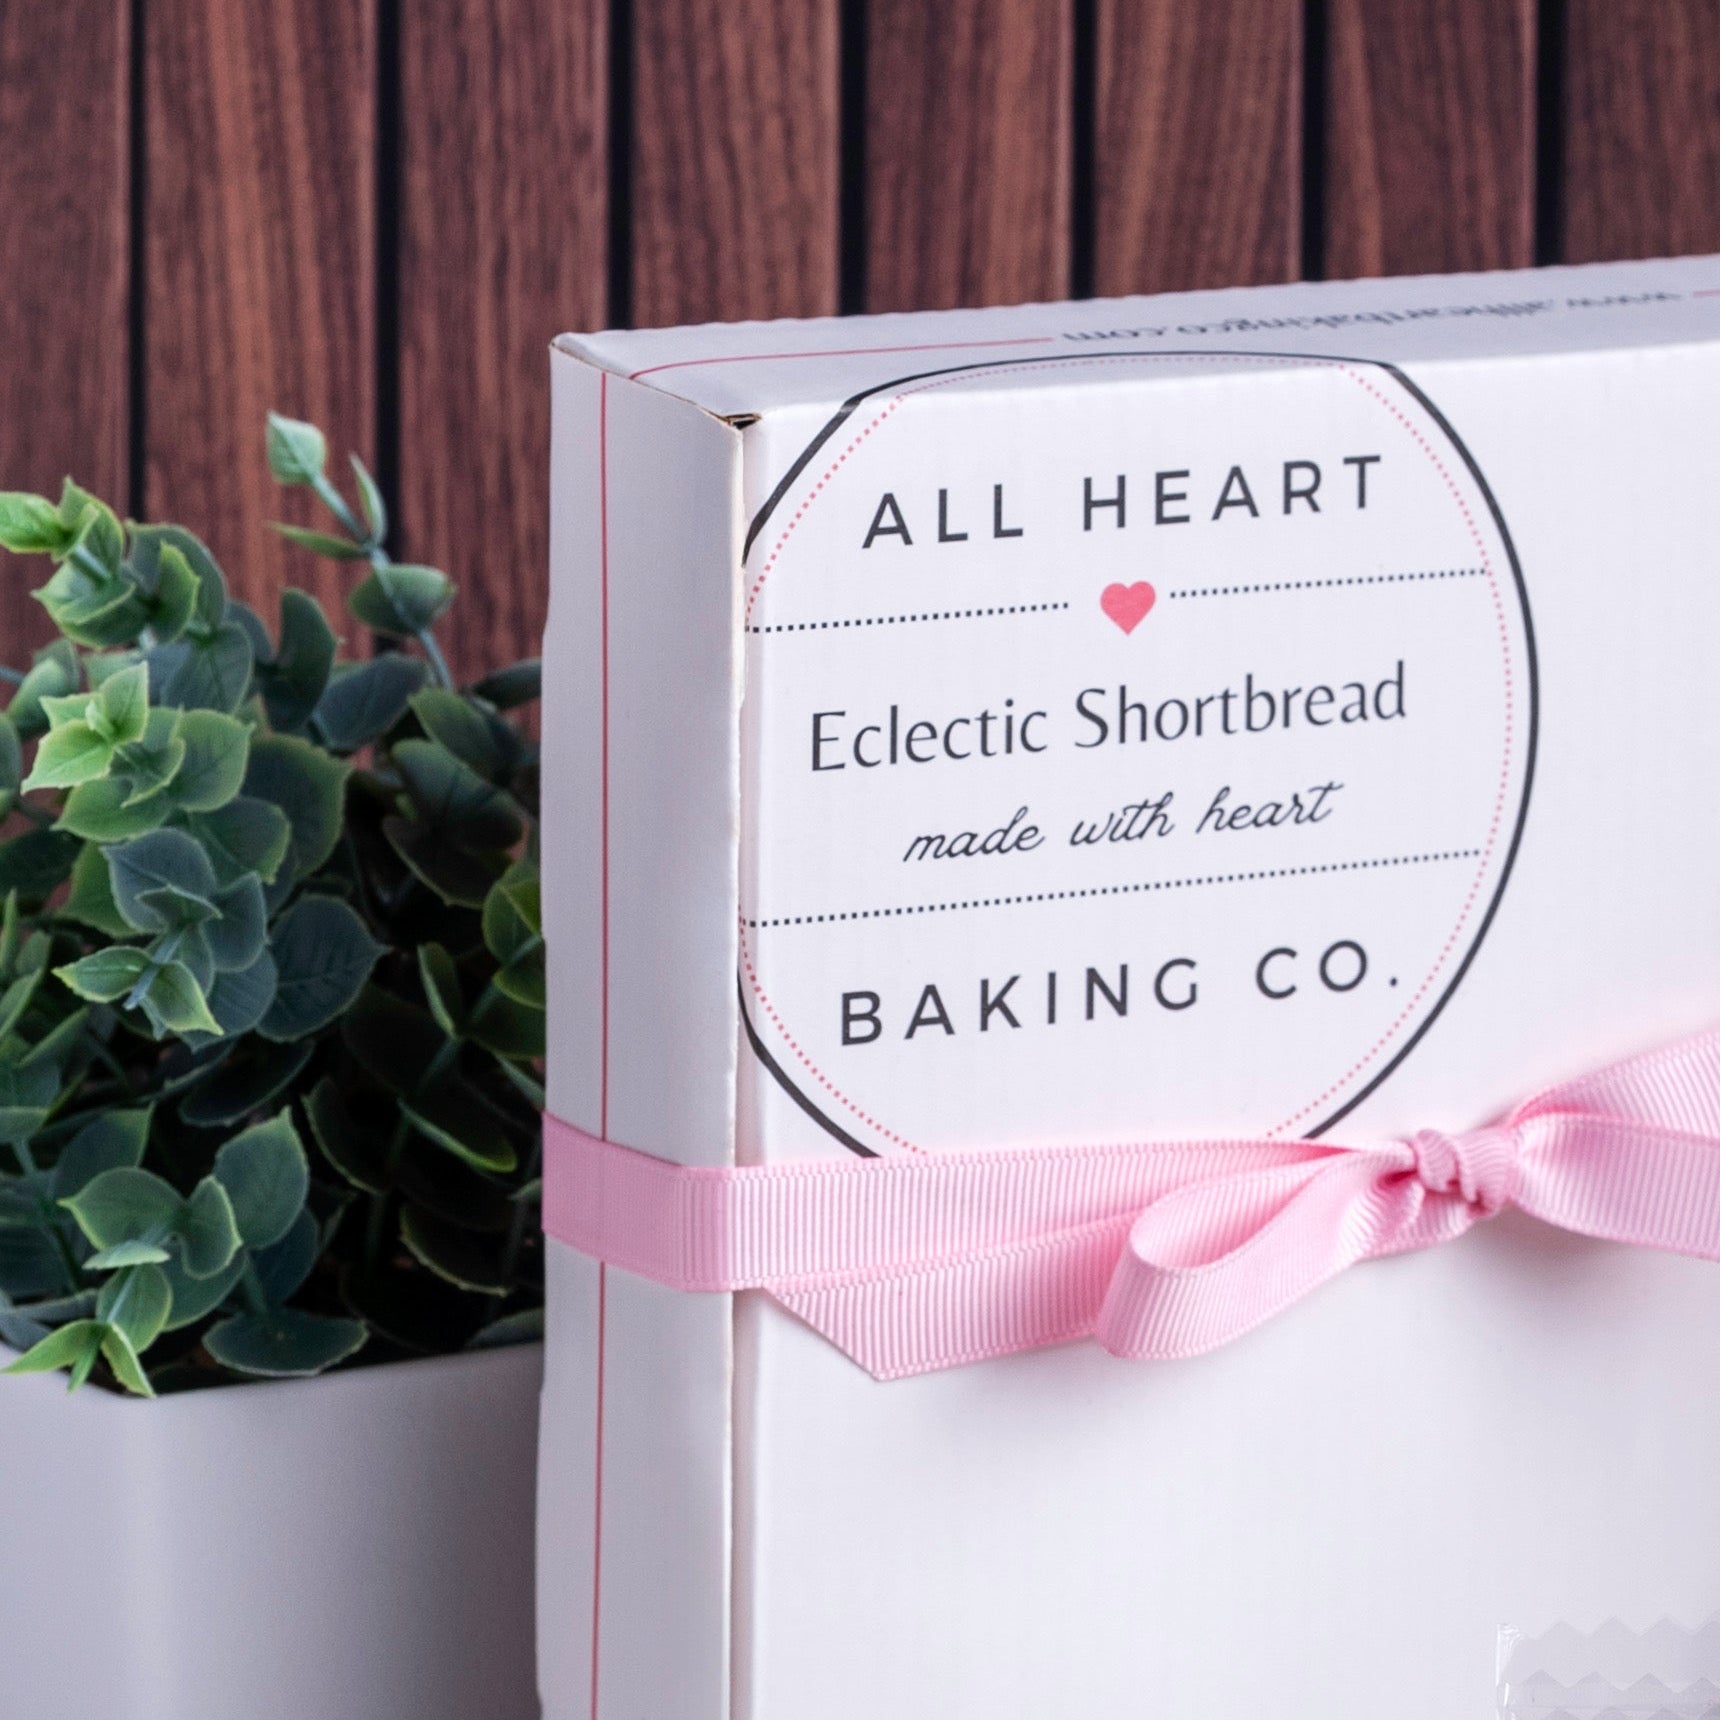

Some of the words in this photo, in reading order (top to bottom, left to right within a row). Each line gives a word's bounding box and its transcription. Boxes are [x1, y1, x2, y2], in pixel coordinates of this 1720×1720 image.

[861, 483, 1024, 550] ALL
[1083, 454, 1381, 532] HEART
[811, 698, 1047, 772] Eclectic
[1074, 659, 1406, 748] Shortbread
[902, 805, 1045, 863] made
[1069, 791, 1175, 847] with
[1195, 781, 1344, 834] heart
[841, 957, 1198, 1047] BAKING
[1255, 939, 1398, 1000] CO.
